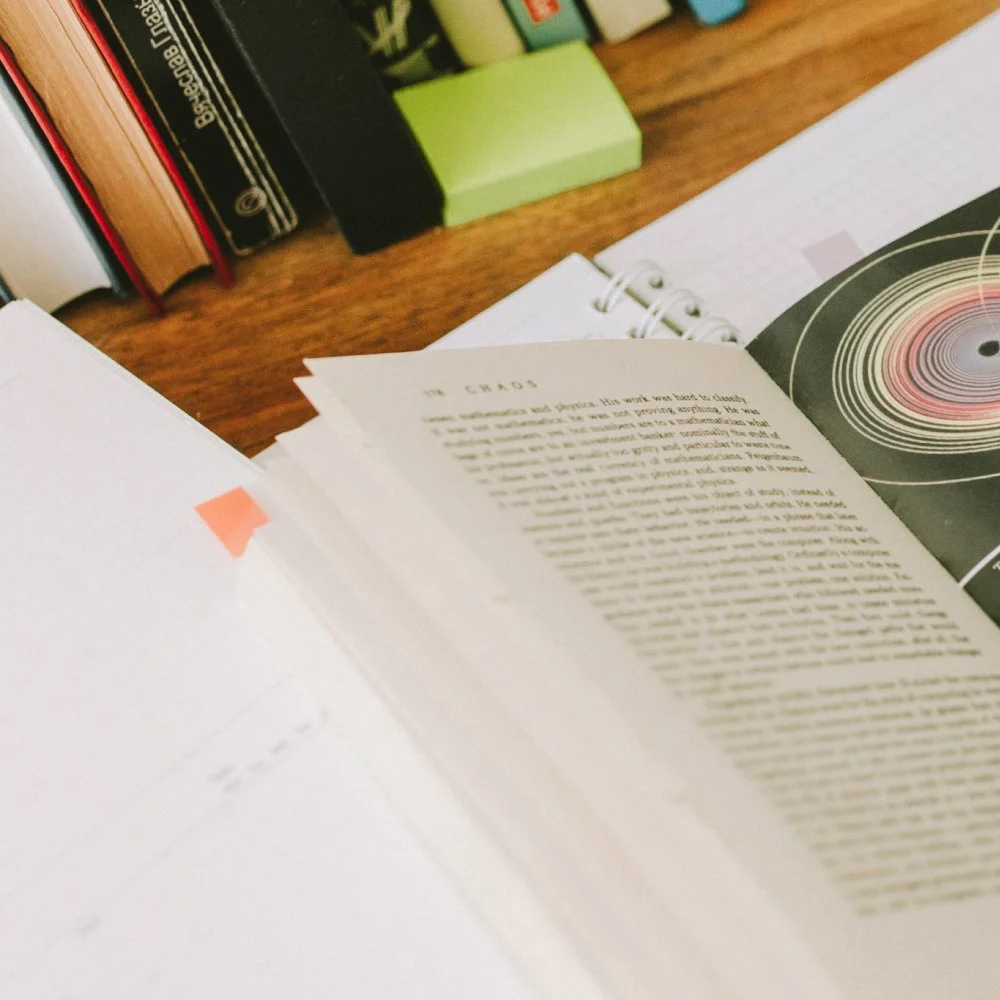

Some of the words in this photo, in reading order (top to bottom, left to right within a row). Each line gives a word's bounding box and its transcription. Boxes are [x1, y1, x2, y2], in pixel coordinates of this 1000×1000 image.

[162, 40, 216, 129] Вячеслав
[600, 398, 620, 406] His
[624, 395, 648, 404] work
[673, 393, 698, 401] hard
[635, 408, 676, 417] proving
[676, 418, 746, 426] mathematician
[748, 419, 769, 428] what
[680, 429, 729, 437] nominally
